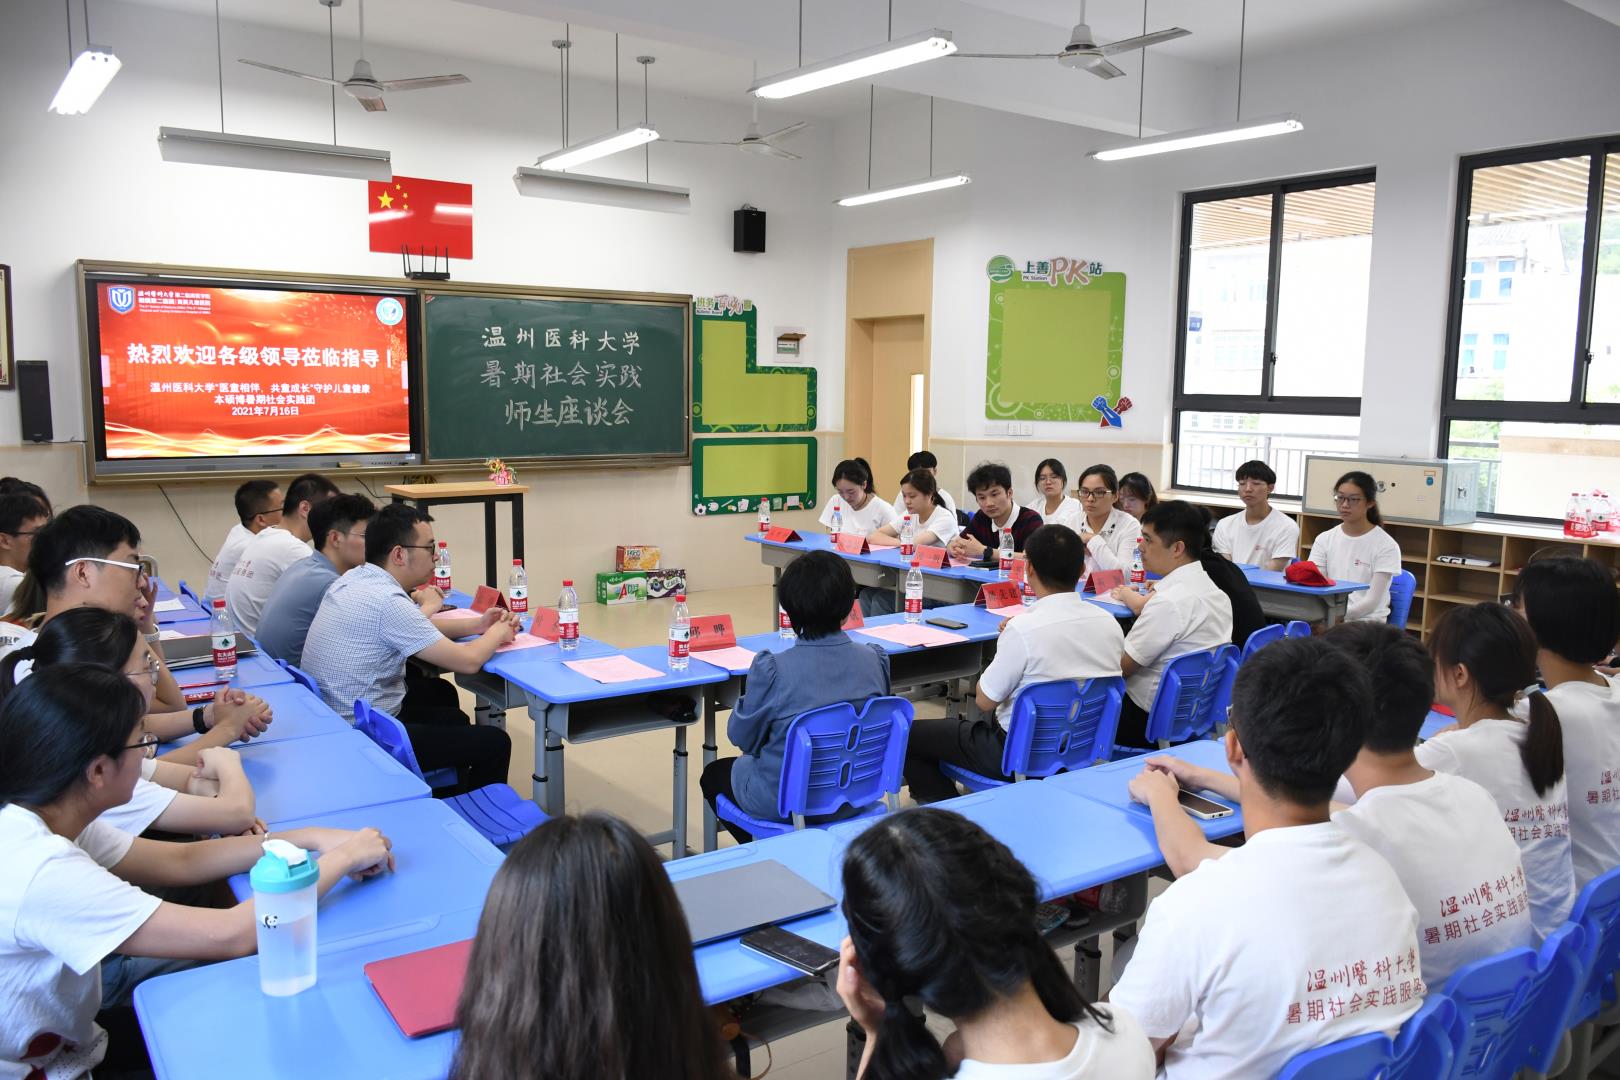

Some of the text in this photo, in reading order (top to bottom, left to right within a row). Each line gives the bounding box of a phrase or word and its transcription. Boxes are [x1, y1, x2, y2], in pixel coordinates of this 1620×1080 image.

[1022, 257, 1103, 286] 上善PK站
[481, 326, 640, 355] 温州医科大学
[480, 360, 642, 389] 暑期社会实践
[231, 406, 299, 416] 2021年7月16日
[505, 395, 635, 431] 师生座谈会
